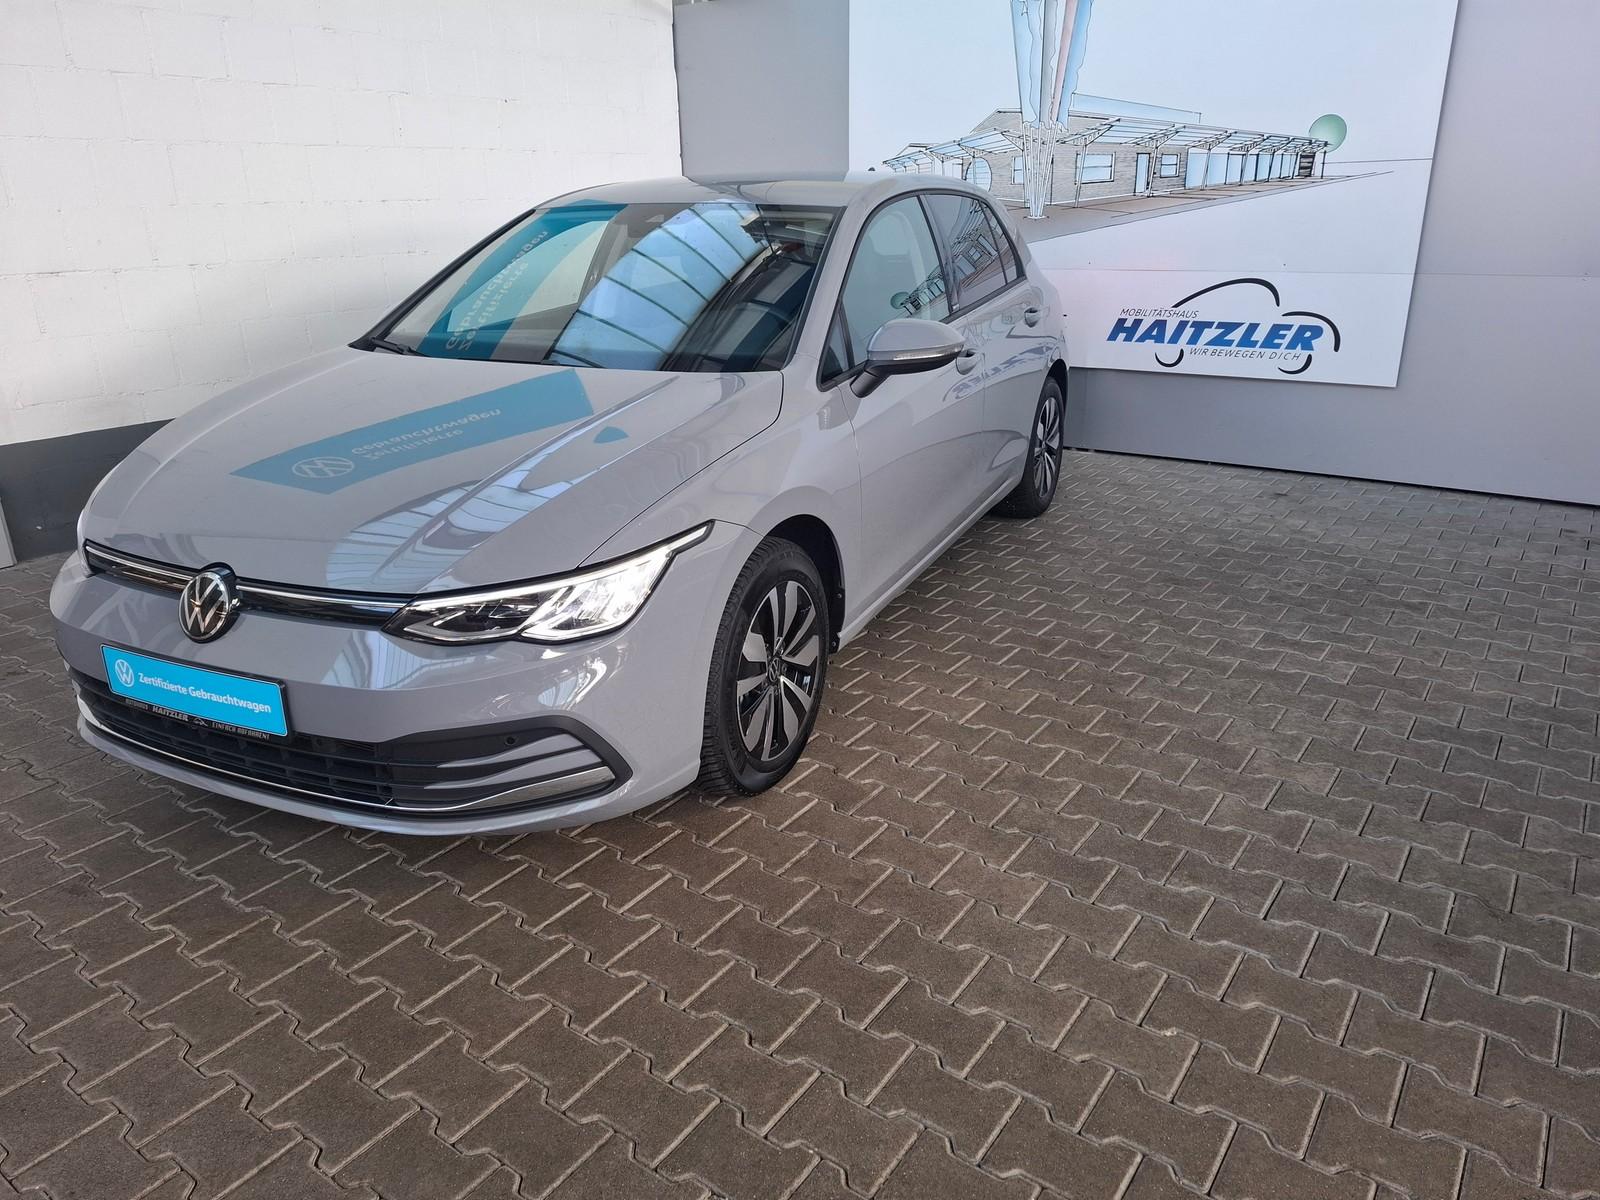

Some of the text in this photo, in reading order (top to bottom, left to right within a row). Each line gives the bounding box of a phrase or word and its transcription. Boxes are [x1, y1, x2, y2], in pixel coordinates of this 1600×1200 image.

[1119, 307, 1199, 319] MOBILITÄTSHAUS
[1106, 318, 1324, 351] HAITZLER
[1189, 347, 1301, 361] WIR BEWEGEN DICH
[138, 672, 272, 714] Zertifizierte Gebrauchtwagen
[152, 704, 188, 722] HAITZLER
